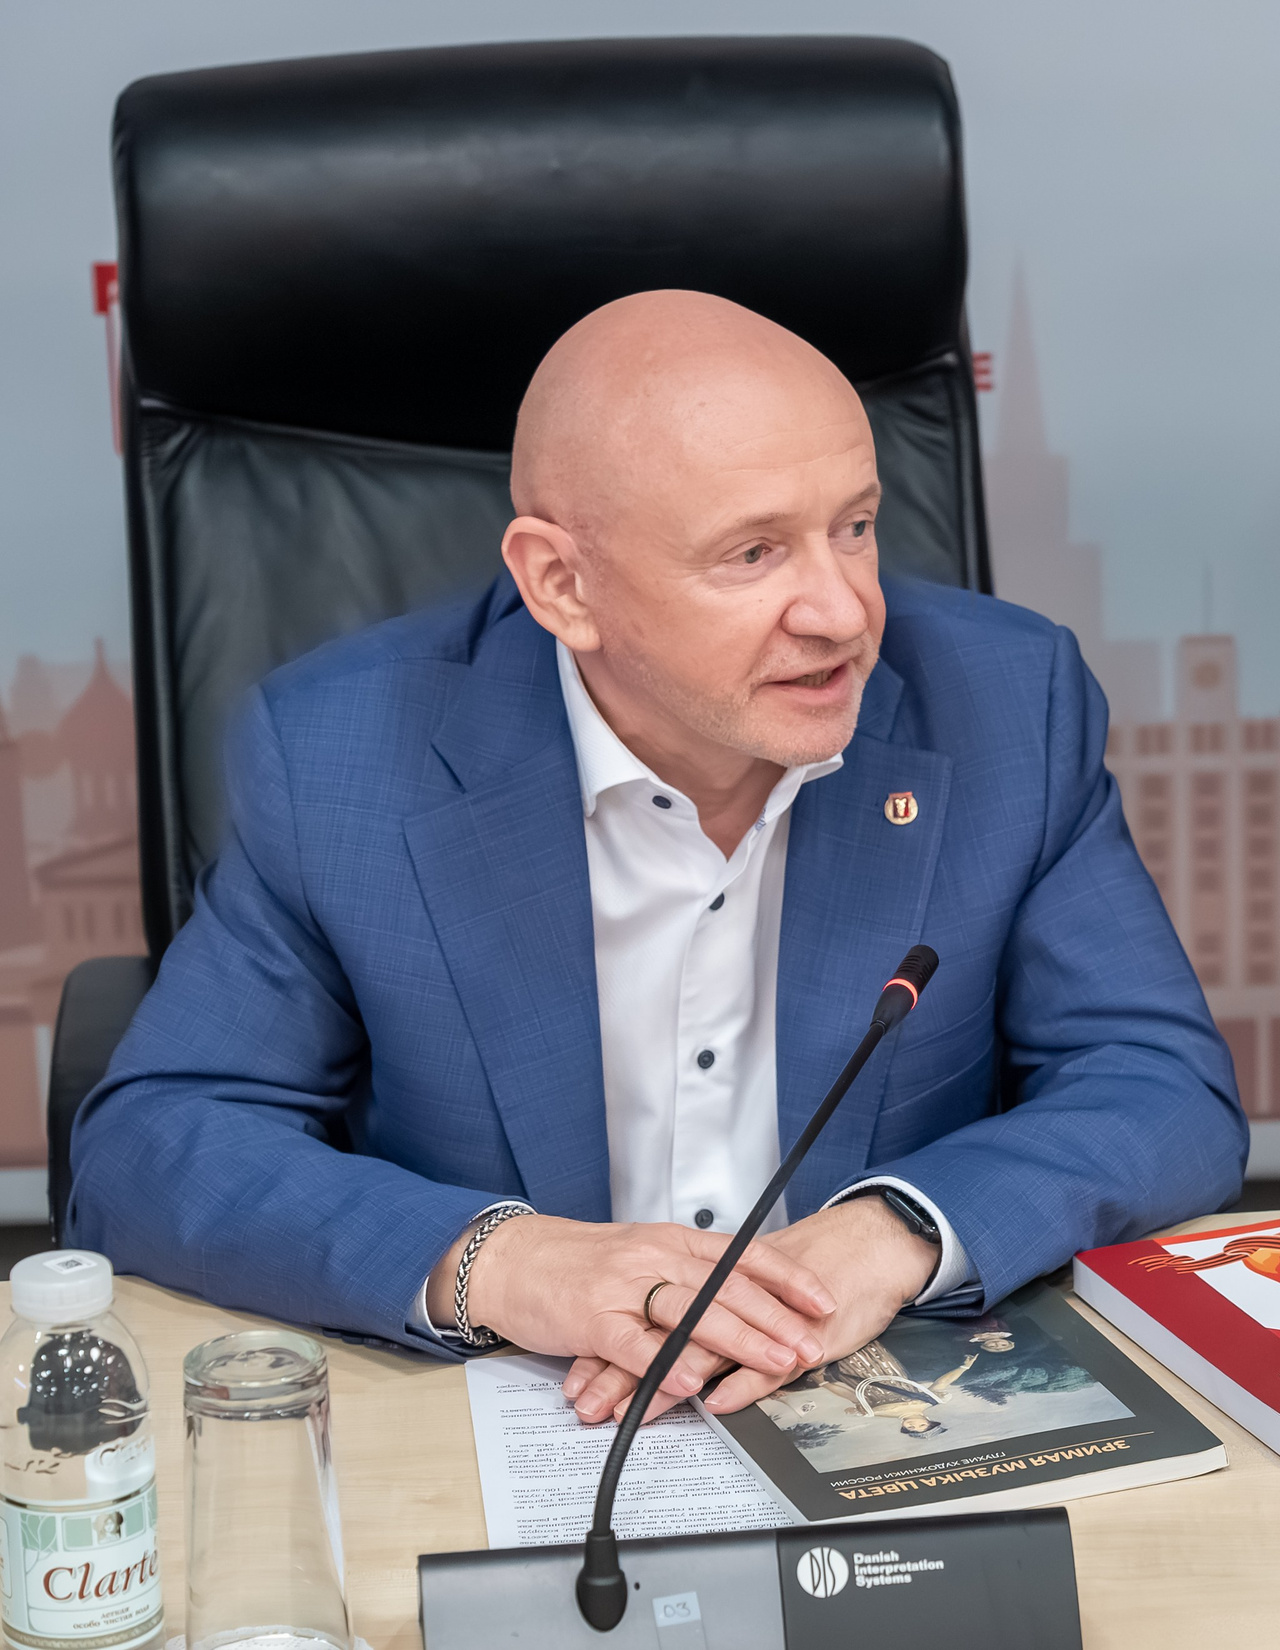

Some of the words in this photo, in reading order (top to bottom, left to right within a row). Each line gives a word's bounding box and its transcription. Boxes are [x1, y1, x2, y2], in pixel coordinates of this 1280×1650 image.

[960, 1451, 1006, 1465] ГЛУХИЕ
[1028, 1439, 1130, 1467] ЗРИМАЯ
[884, 1460, 959, 1479] ХУДОЖНИКИ
[920, 1459, 1026, 1486] МУЗЫКА
[830, 1474, 882, 1487] РОССИИ
[838, 1480, 916, 1500] ЦВЕТА
[853, 1550, 900, 1565] Danish
[854, 1559, 945, 1576] Interpretation
[855, 1573, 913, 1589] Systems
